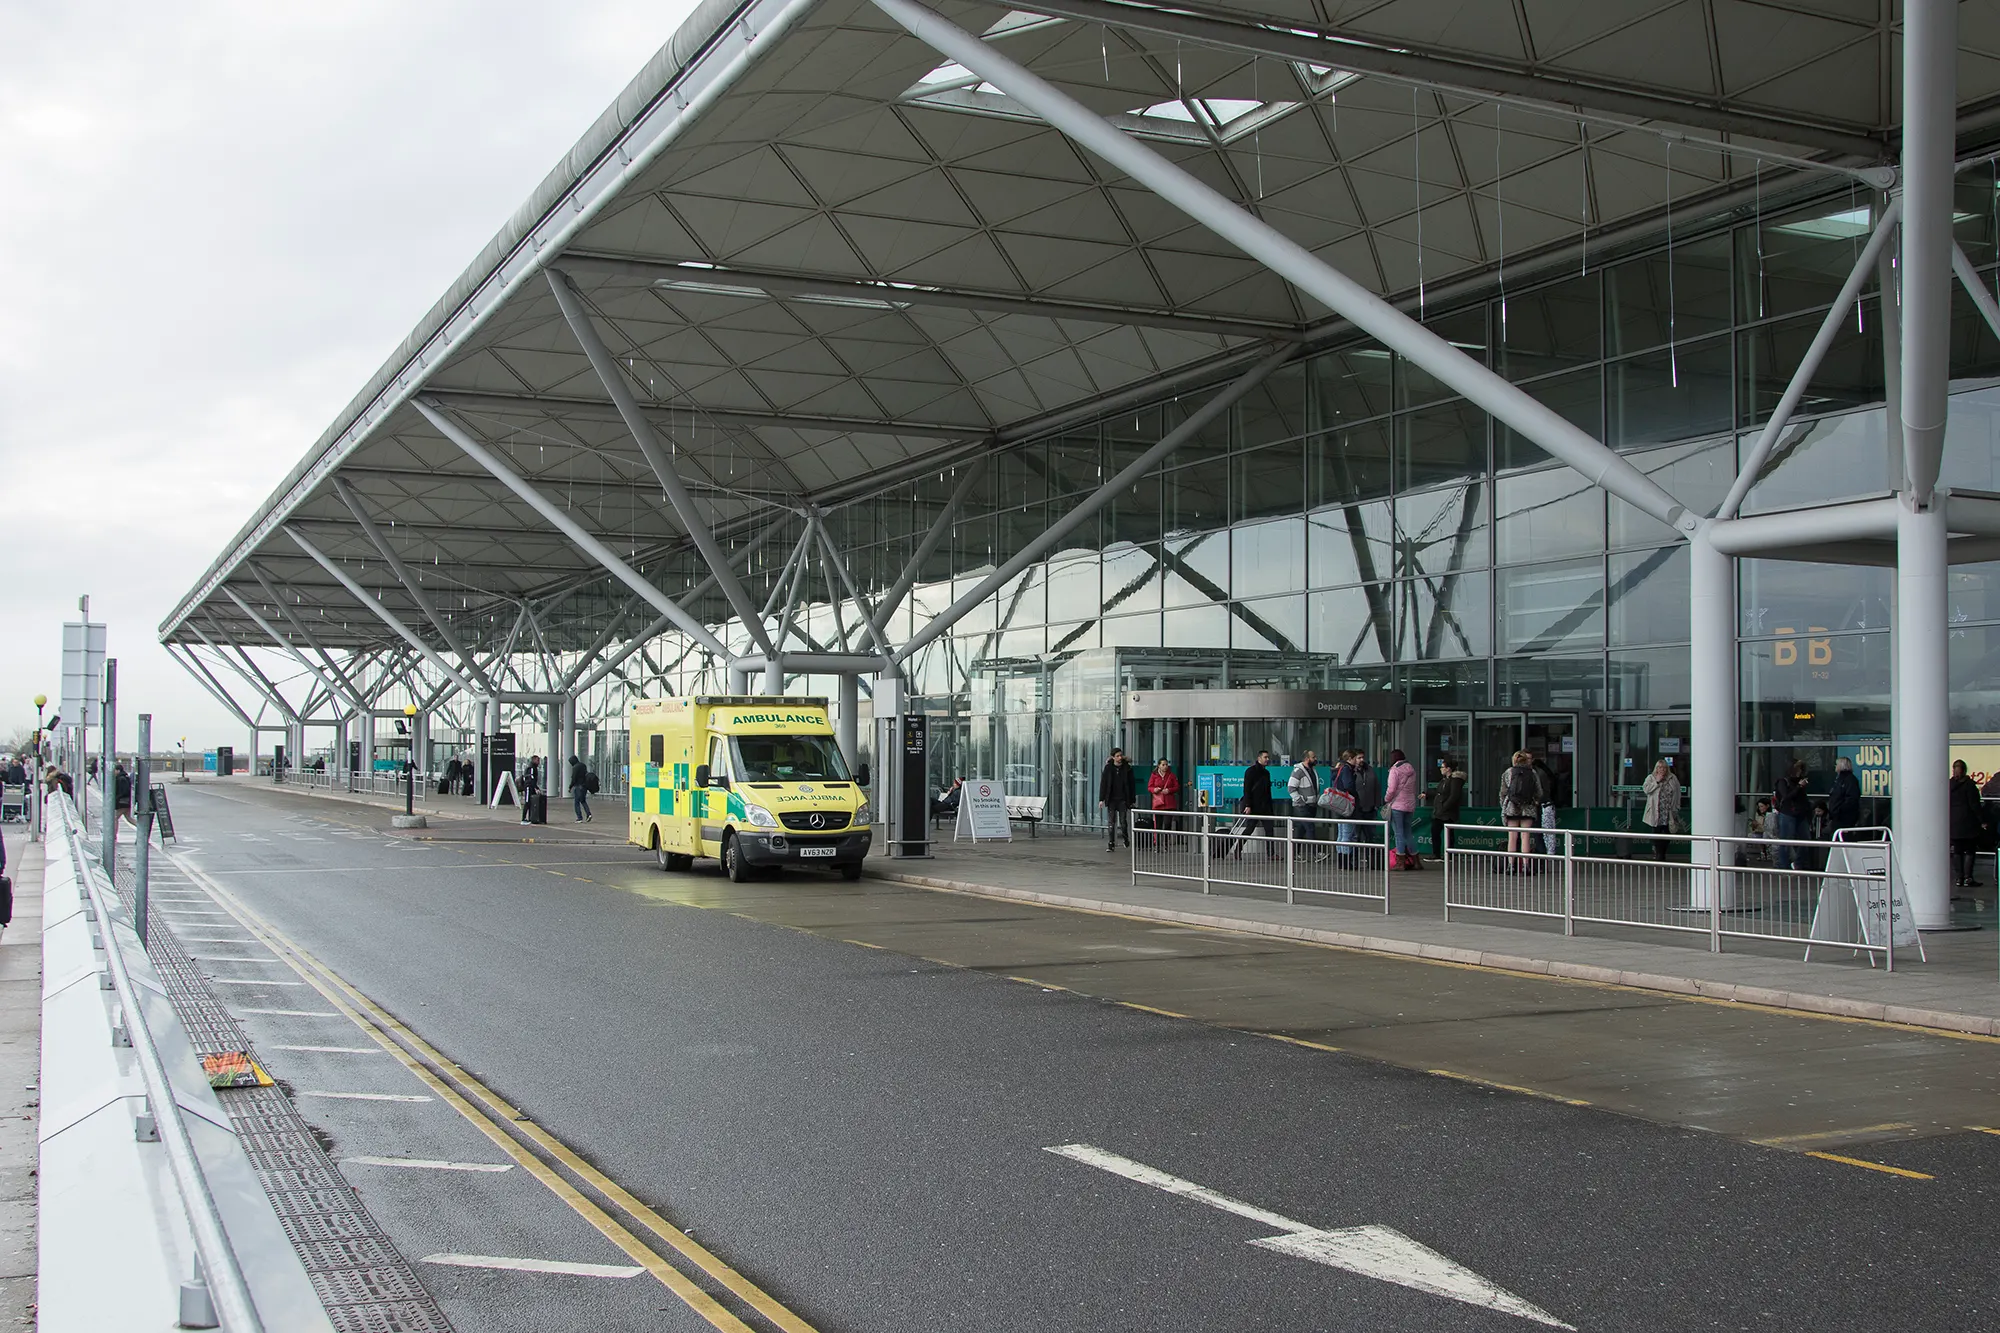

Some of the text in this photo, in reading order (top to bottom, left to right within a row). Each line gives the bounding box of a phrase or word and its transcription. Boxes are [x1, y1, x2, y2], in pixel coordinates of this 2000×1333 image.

[1775, 626, 1832, 666] B B
[1317, 702, 1358, 711] Departures
[733, 714, 825, 726] AMBULANCE
[1856, 738, 1890, 766] JUST
[1457, 835, 1494, 848] Smoking
[803, 848, 834, 856] AV63 NZR
[1867, 900, 1879, 909] Car
